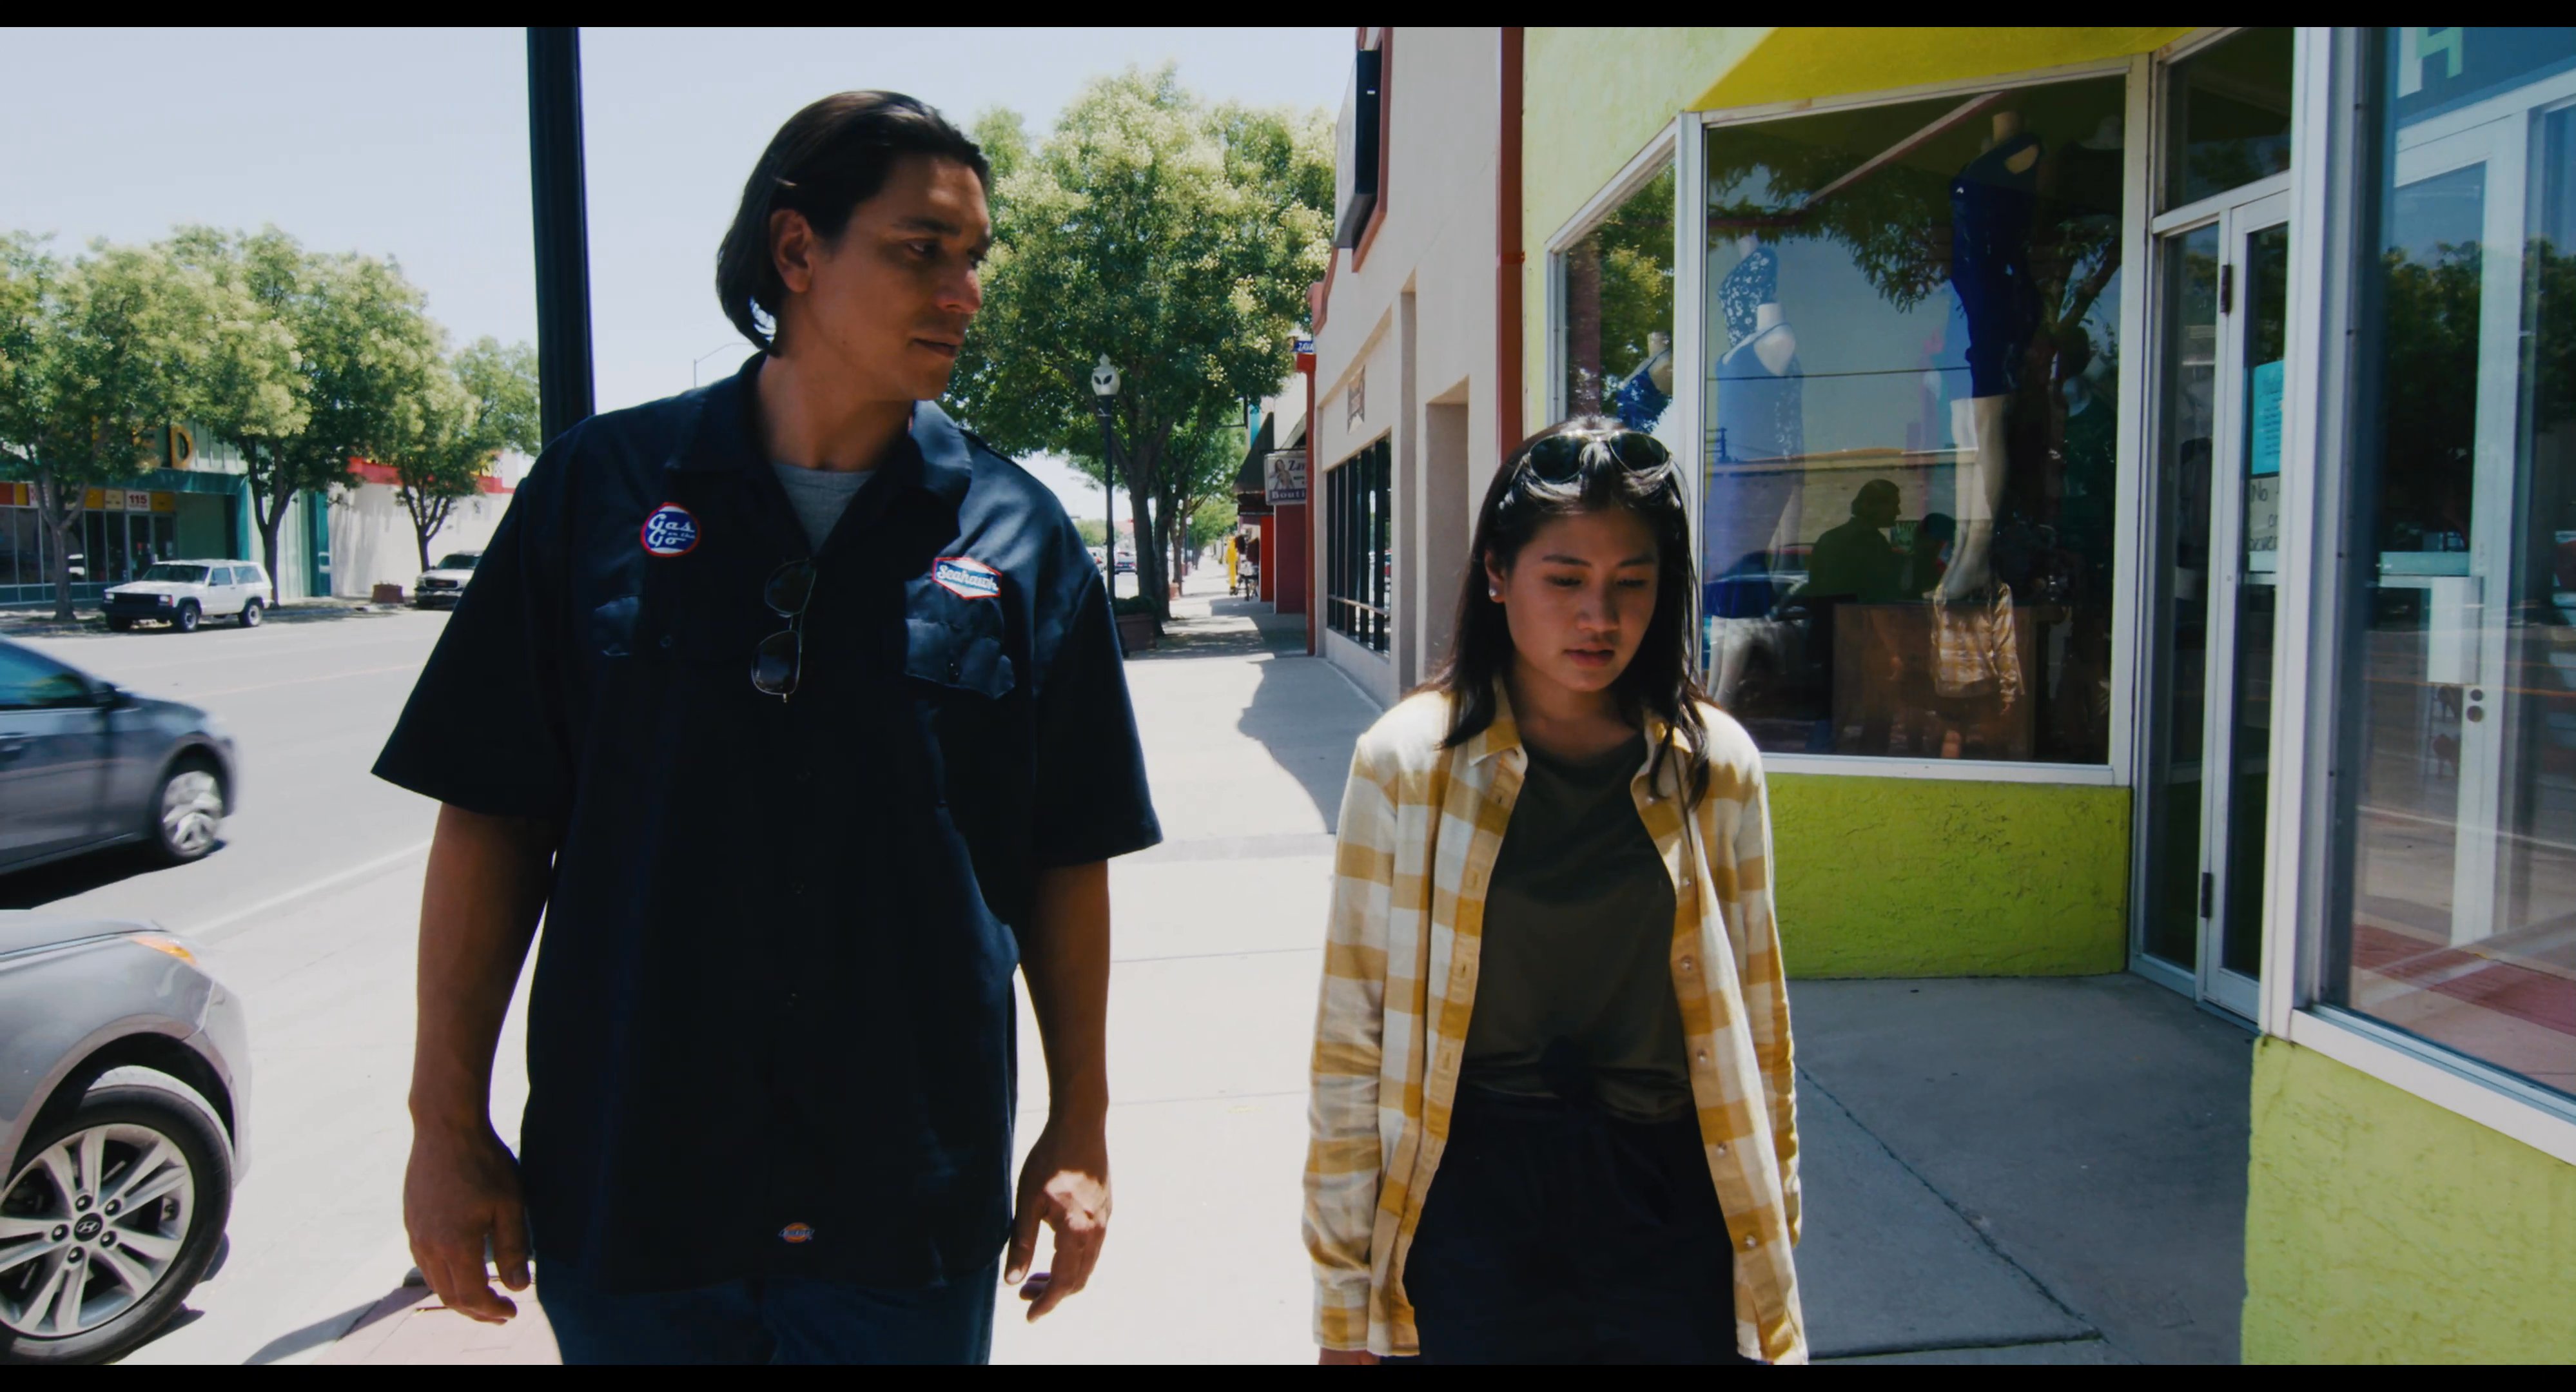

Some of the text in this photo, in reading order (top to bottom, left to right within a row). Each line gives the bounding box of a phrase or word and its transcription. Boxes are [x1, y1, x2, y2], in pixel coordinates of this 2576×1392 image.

[129, 494, 148, 504] 115
[648, 514, 695, 533] Gas
[648, 528, 686, 546] Go
